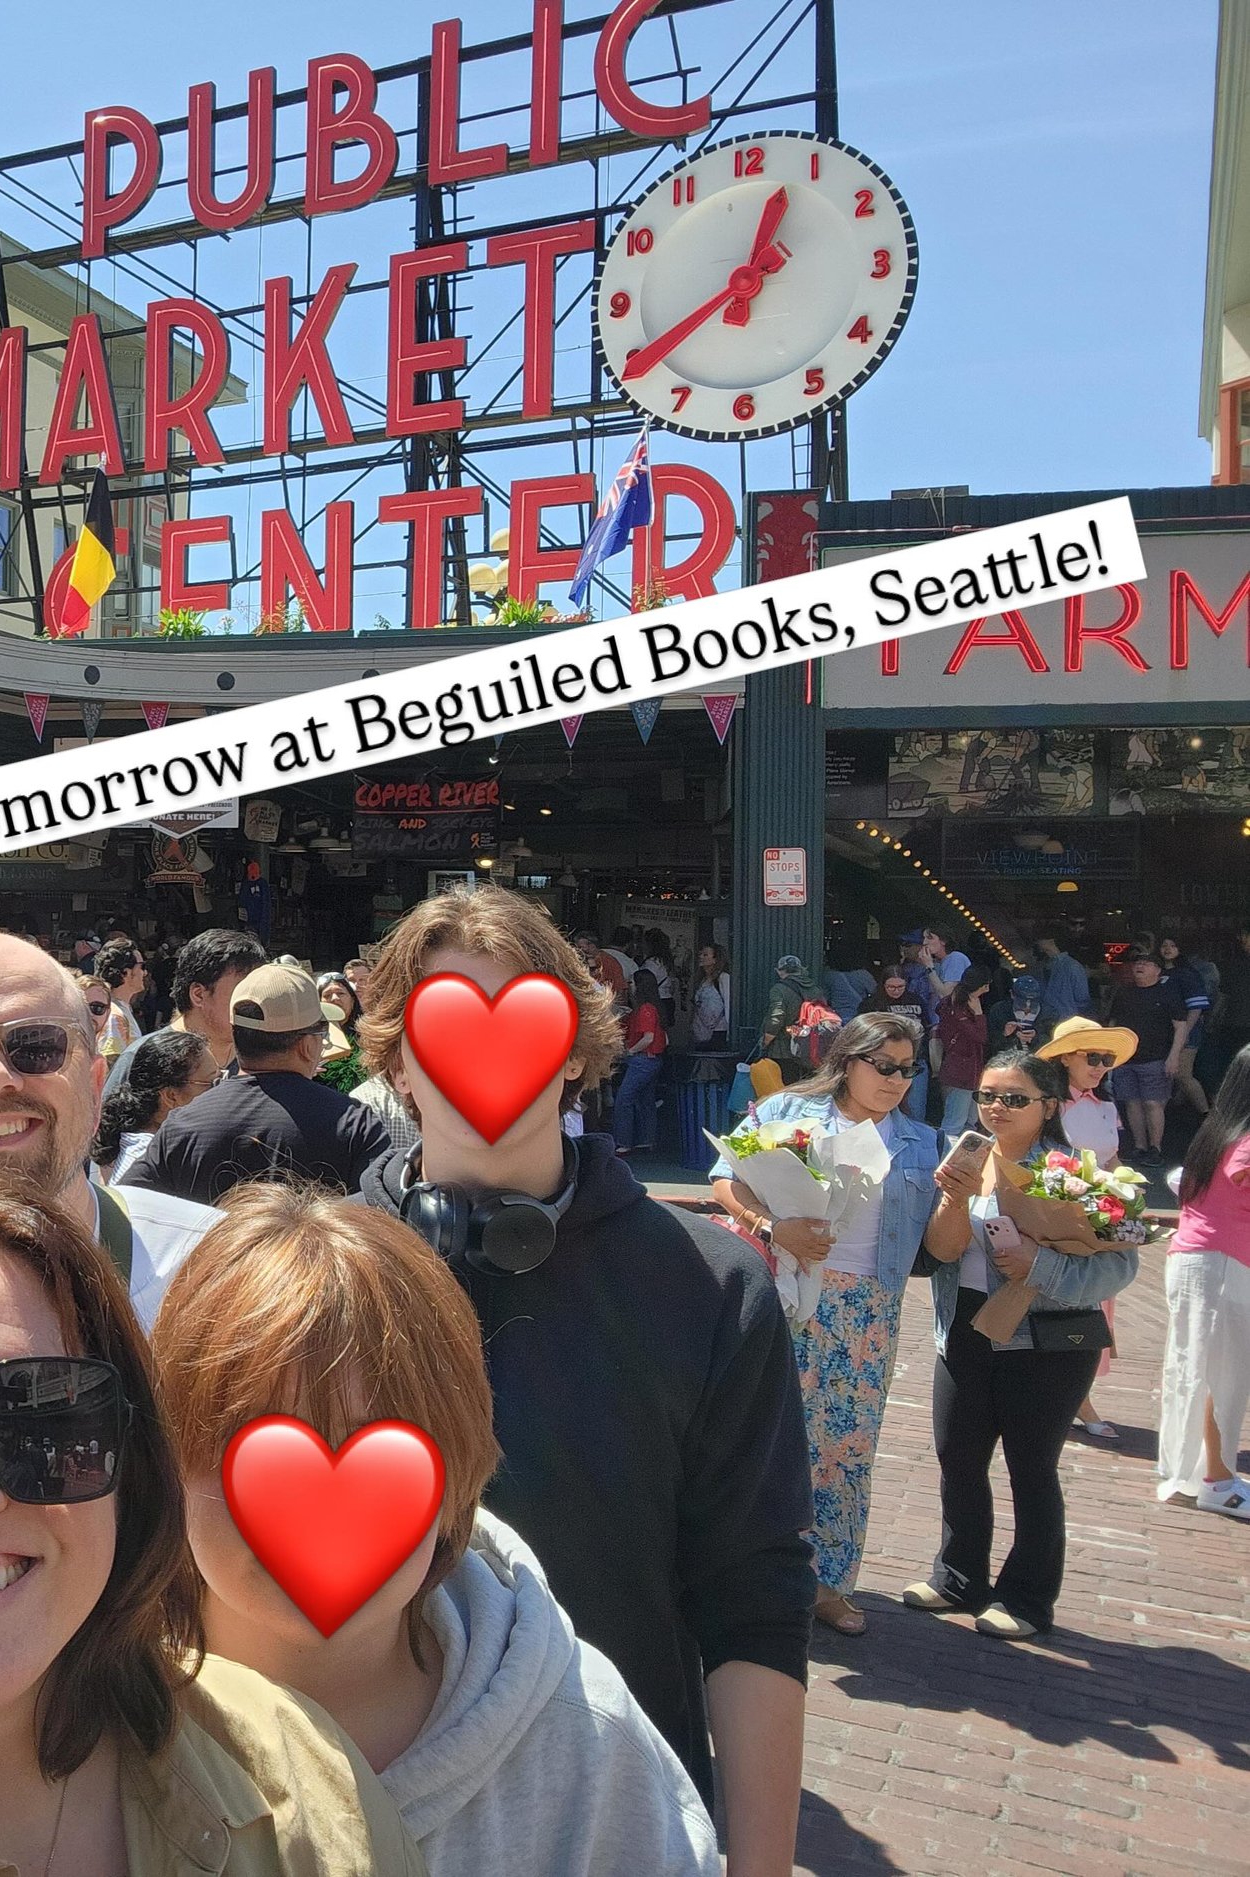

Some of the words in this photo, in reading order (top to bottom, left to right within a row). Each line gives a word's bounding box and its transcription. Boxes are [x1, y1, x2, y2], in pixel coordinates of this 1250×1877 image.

[81, 0, 711, 260] PUBLIC
[734, 147, 765, 178] 12
[811, 153, 819, 181] 1
[673, 175, 694, 206] 11
[854, 189, 875, 218] 2
[627, 227, 654, 256] 10
[870, 248, 891, 280] 3
[609, 291, 632, 319] 9
[847, 315, 873, 344] 4
[803, 367, 825, 396] 5
[671, 386, 692, 413] 7
[732, 394, 755, 421] 6
[355, 783, 432, 807] COPPER
[439, 780, 499, 806] RIVER
[399, 818, 427, 829] AND
[431, 817, 495, 829] SOCKEYE
[353, 832, 460, 850] SALMON
[767, 851, 778, 859] NO
[770, 863, 800, 871] STOPS
